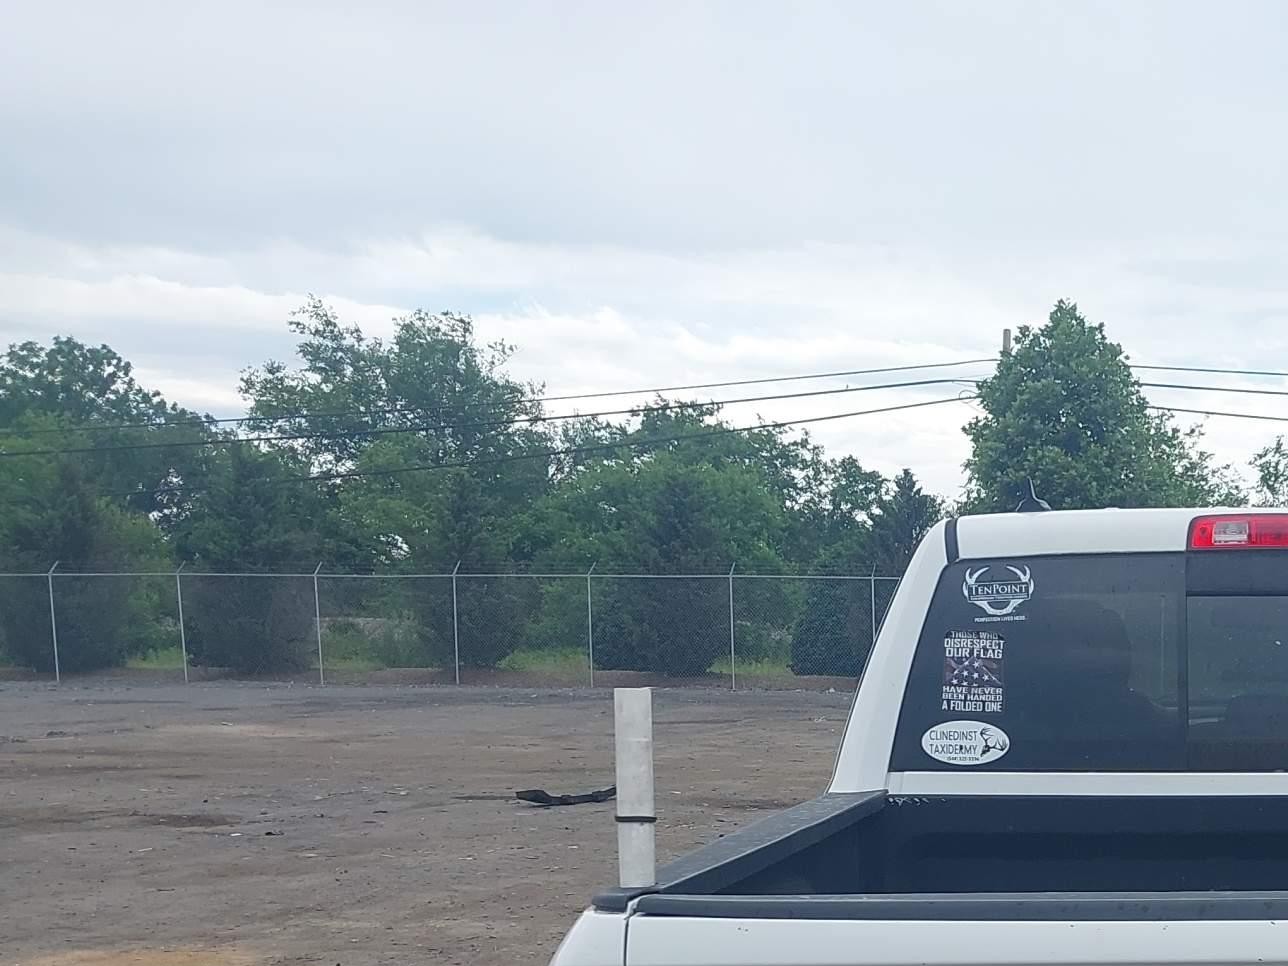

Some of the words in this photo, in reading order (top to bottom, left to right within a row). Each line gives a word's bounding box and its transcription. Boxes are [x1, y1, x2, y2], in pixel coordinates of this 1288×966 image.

[944, 638, 1005, 649] DISRESPECT
[945, 648, 970, 657] OUR
[974, 648, 1003, 659] FLAG
[942, 700, 948, 710] A
[950, 700, 983, 711] FOLDED
[985, 702, 1002, 712] ONE
[929, 730, 978, 741] CLINEDINST
[929, 743, 978, 754] TAXIDERMY
